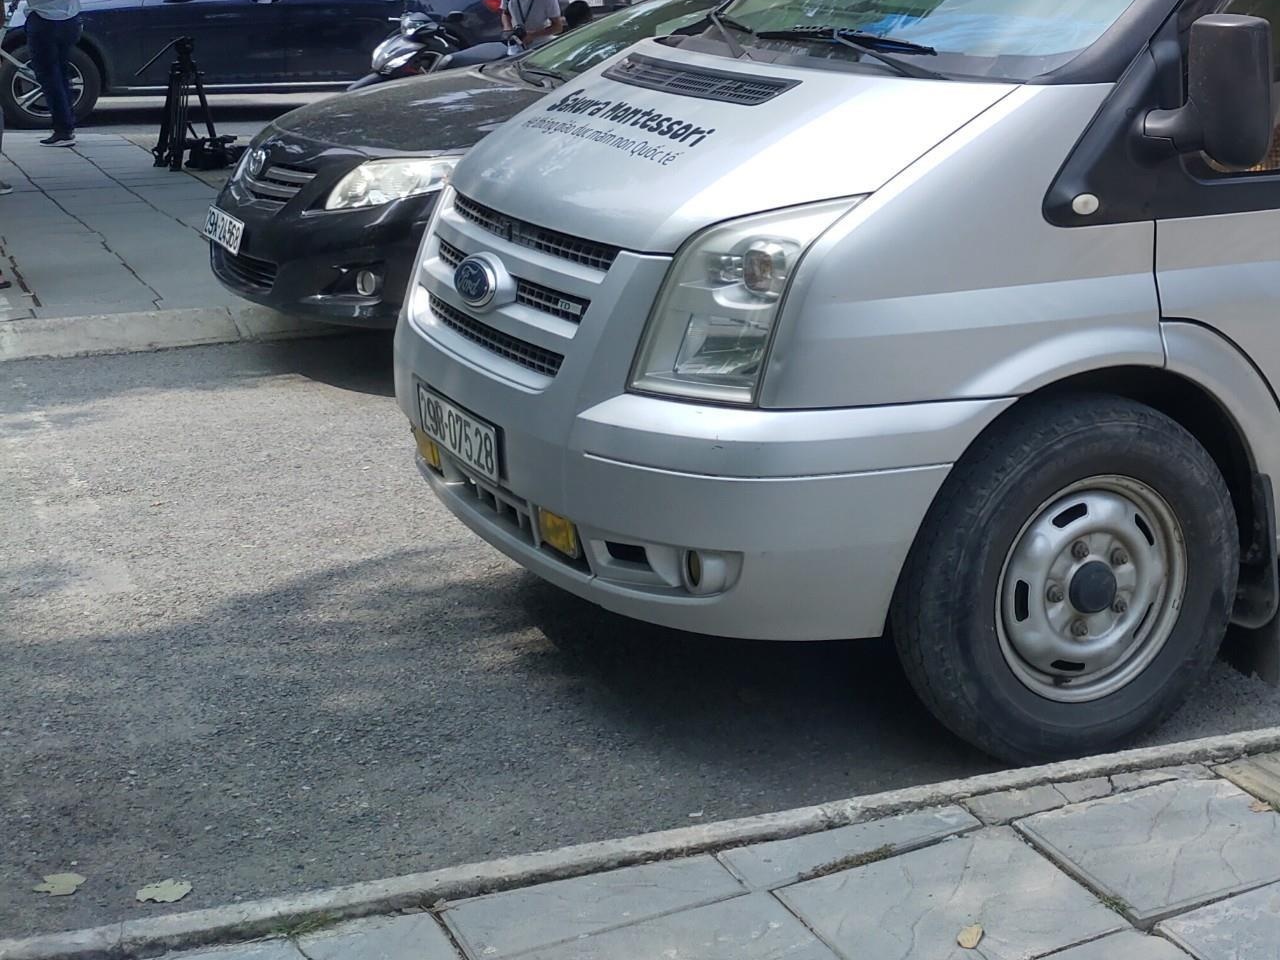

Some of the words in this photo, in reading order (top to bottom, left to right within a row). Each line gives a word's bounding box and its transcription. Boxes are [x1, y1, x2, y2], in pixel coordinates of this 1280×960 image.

[546, 89, 612, 117] Sakura
[598, 101, 716, 147] Montessori
[609, 136, 636, 151] non
[630, 140, 666, 161] Quốc
[657, 151, 685, 166] tế
[457, 265, 481, 296] Ford
